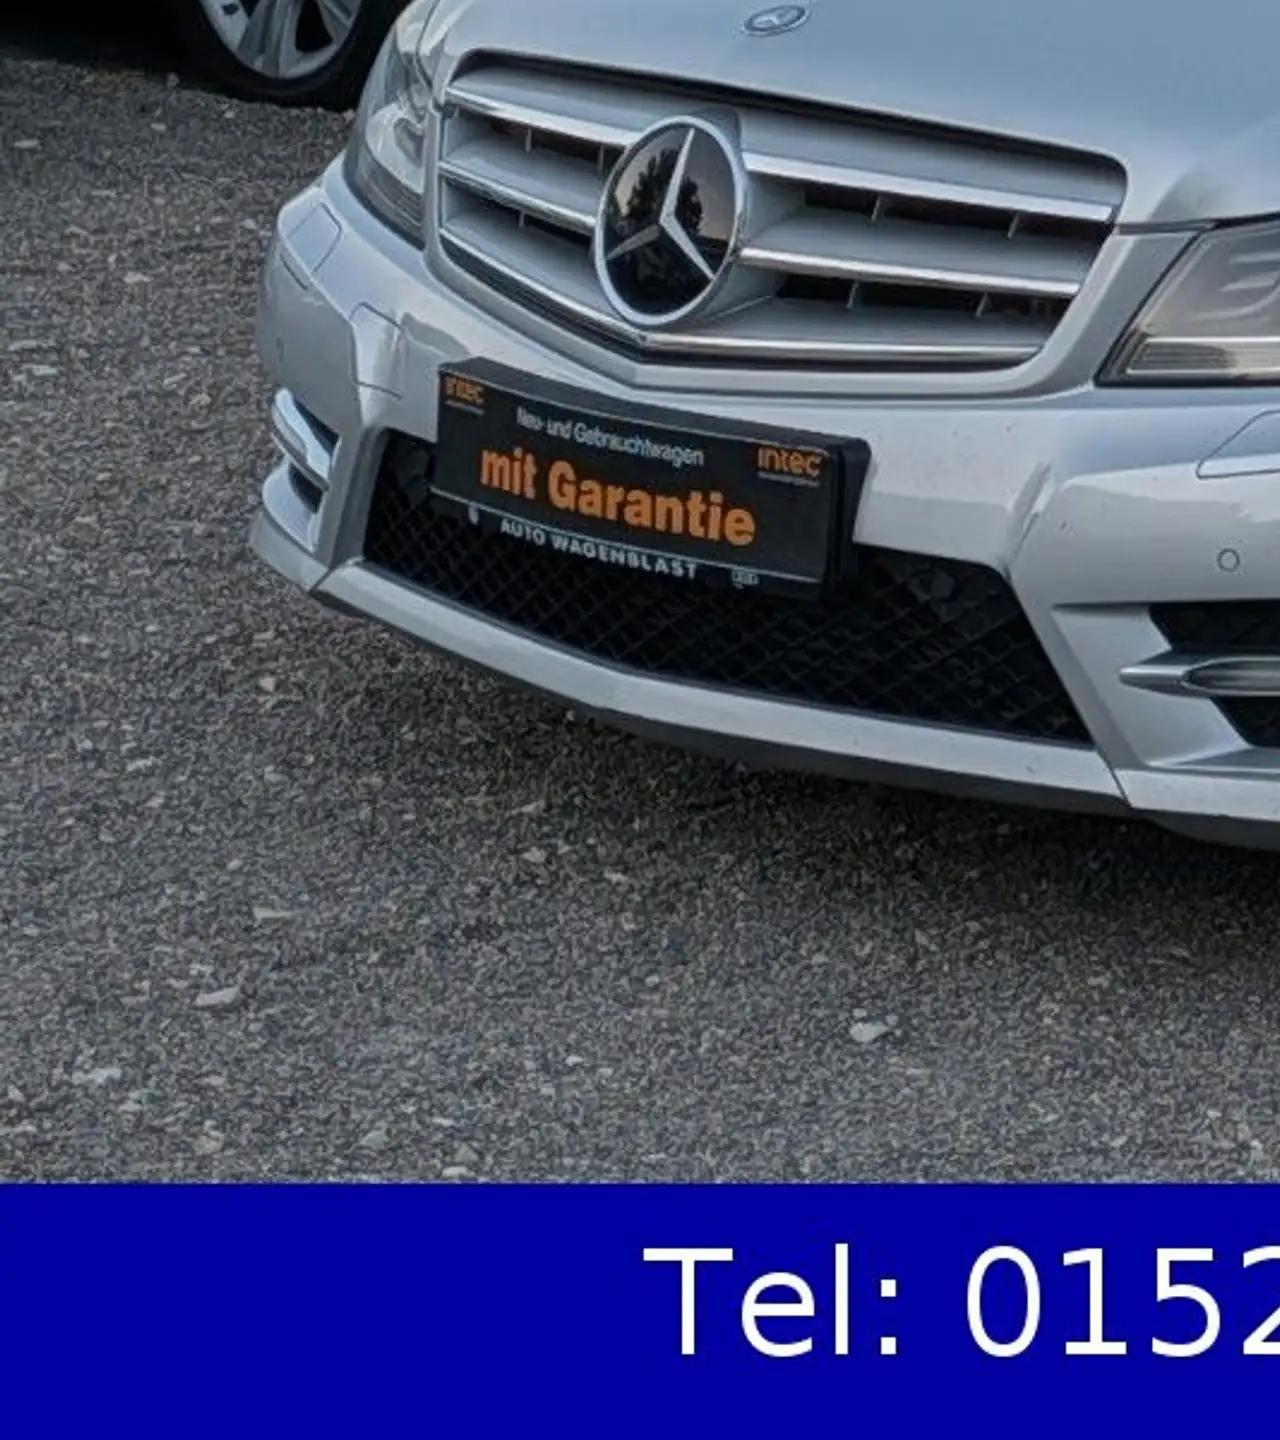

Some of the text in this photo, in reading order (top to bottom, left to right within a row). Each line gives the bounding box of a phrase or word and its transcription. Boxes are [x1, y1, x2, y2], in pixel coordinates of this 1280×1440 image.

[547, 416, 572, 440] und
[573, 421, 705, 469] Gebrauchtwagen
[758, 446, 823, 478] intec
[480, 446, 757, 547] mit Garantie
[499, 518, 547, 547] AUTO
[551, 533, 698, 580] WAGENBLAST
